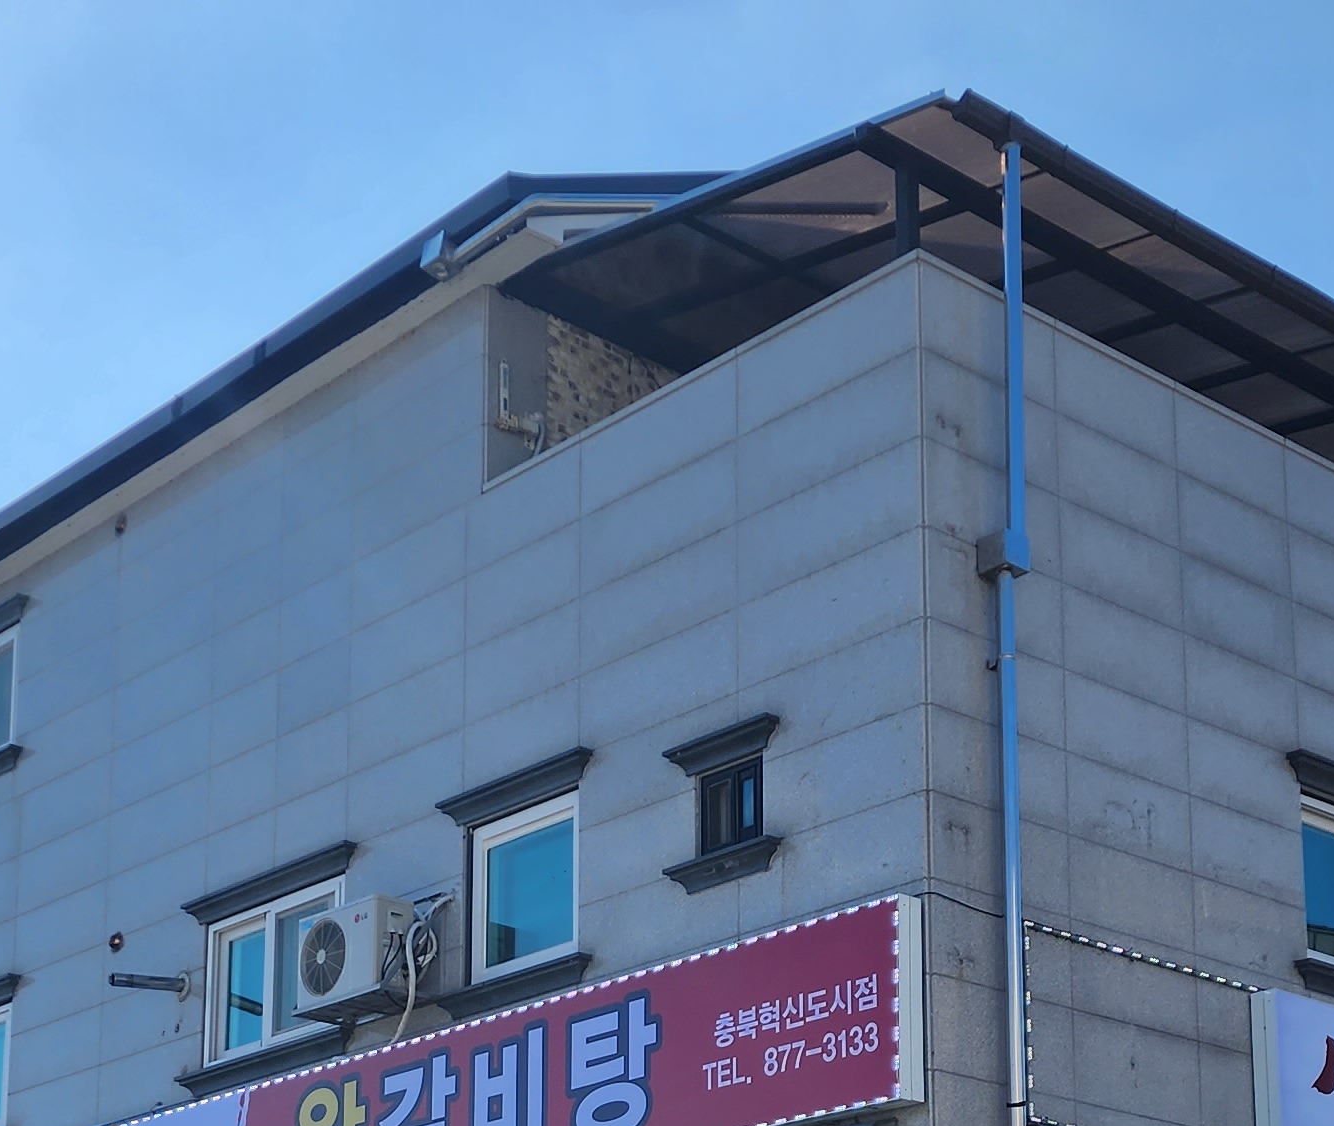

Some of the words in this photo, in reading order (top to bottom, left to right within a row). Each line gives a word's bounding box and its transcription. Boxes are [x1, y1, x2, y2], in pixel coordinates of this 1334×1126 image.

[714, 975, 879, 1048] 충북혁신도시점
[702, 1058, 753, 1091] TEL.
[763, 1022, 879, 1077] 877-3133
